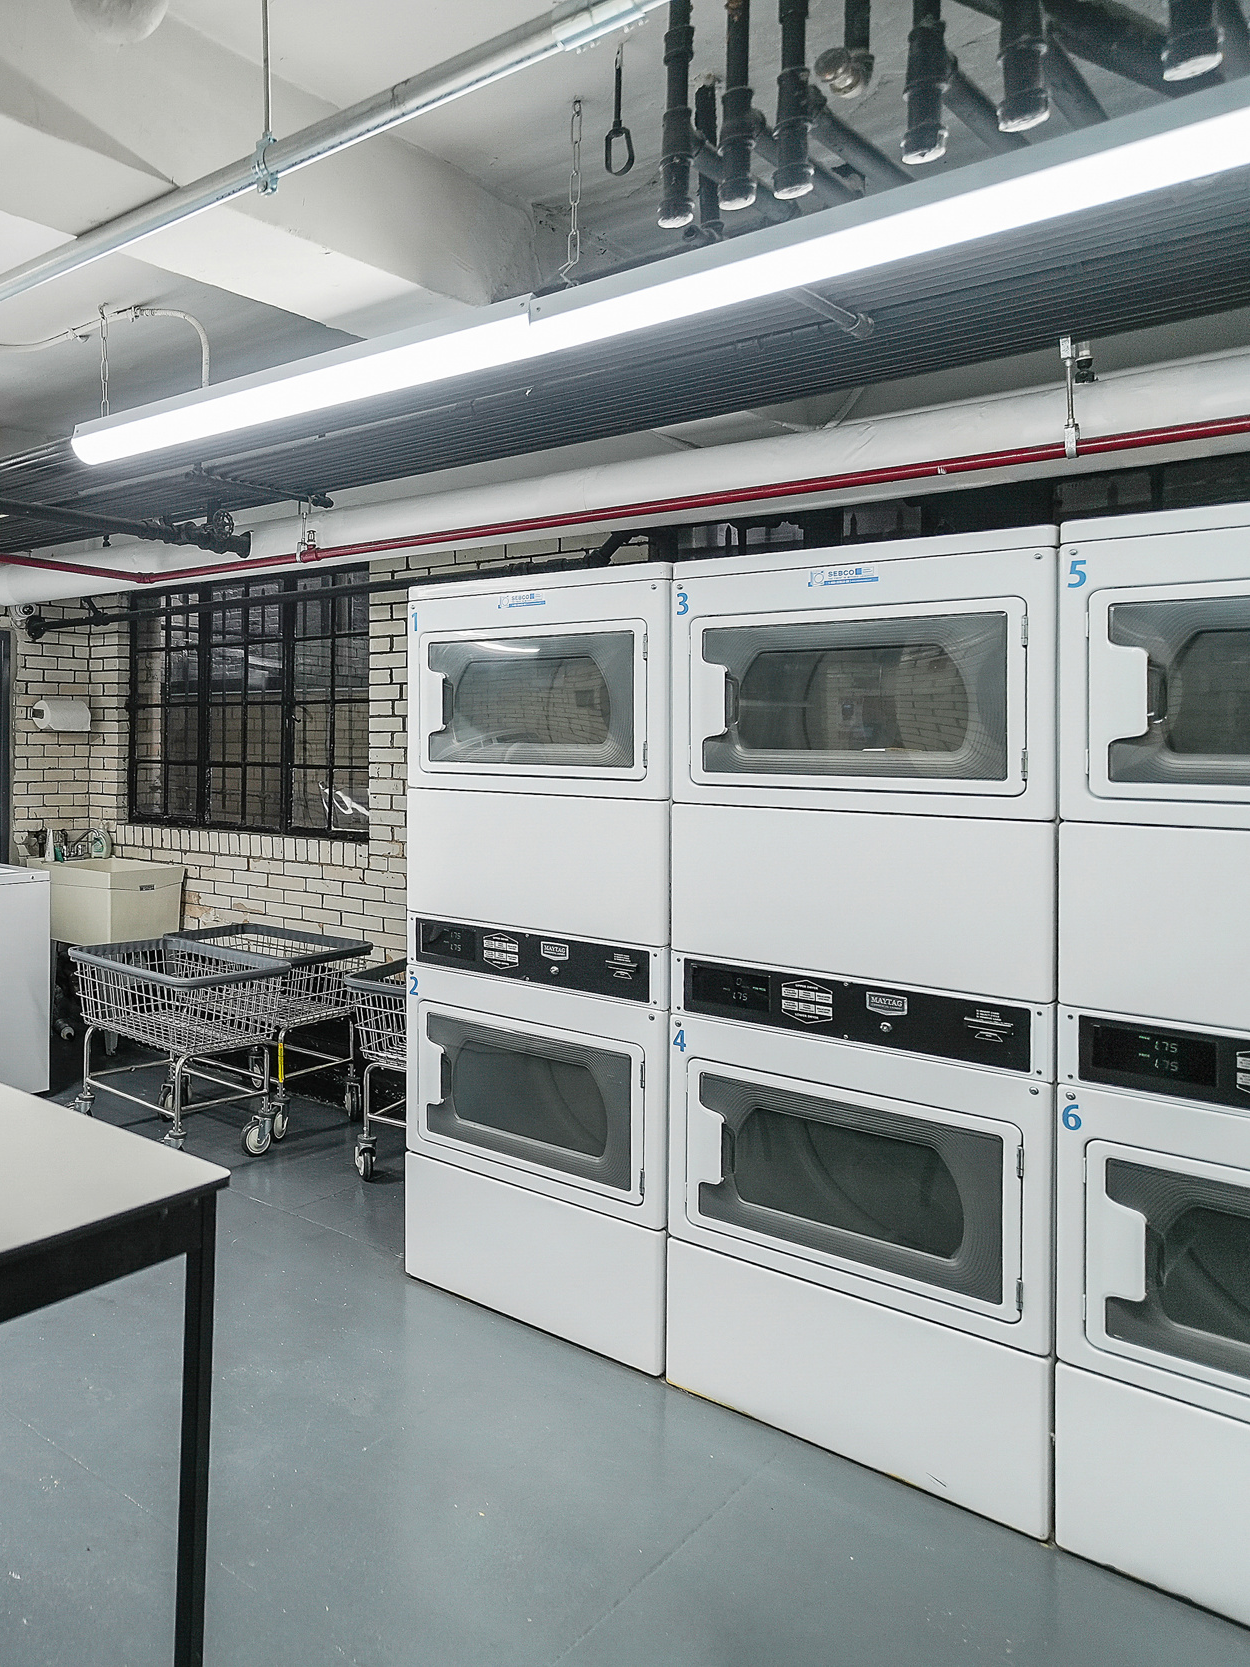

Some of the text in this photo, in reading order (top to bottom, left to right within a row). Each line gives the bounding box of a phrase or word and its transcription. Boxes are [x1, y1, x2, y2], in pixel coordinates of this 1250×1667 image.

[827, 569, 855, 578] SEBCO
[1067, 559, 1087, 589] 5
[676, 592, 689, 615] 3
[411, 612, 418, 632] 1
[543, 944, 566, 954] MAYTAG
[409, 976, 419, 996] 2
[870, 996, 903, 1008] MAYTAG
[672, 1029, 687, 1052] 4
[1062, 1104, 1082, 1131] 6
